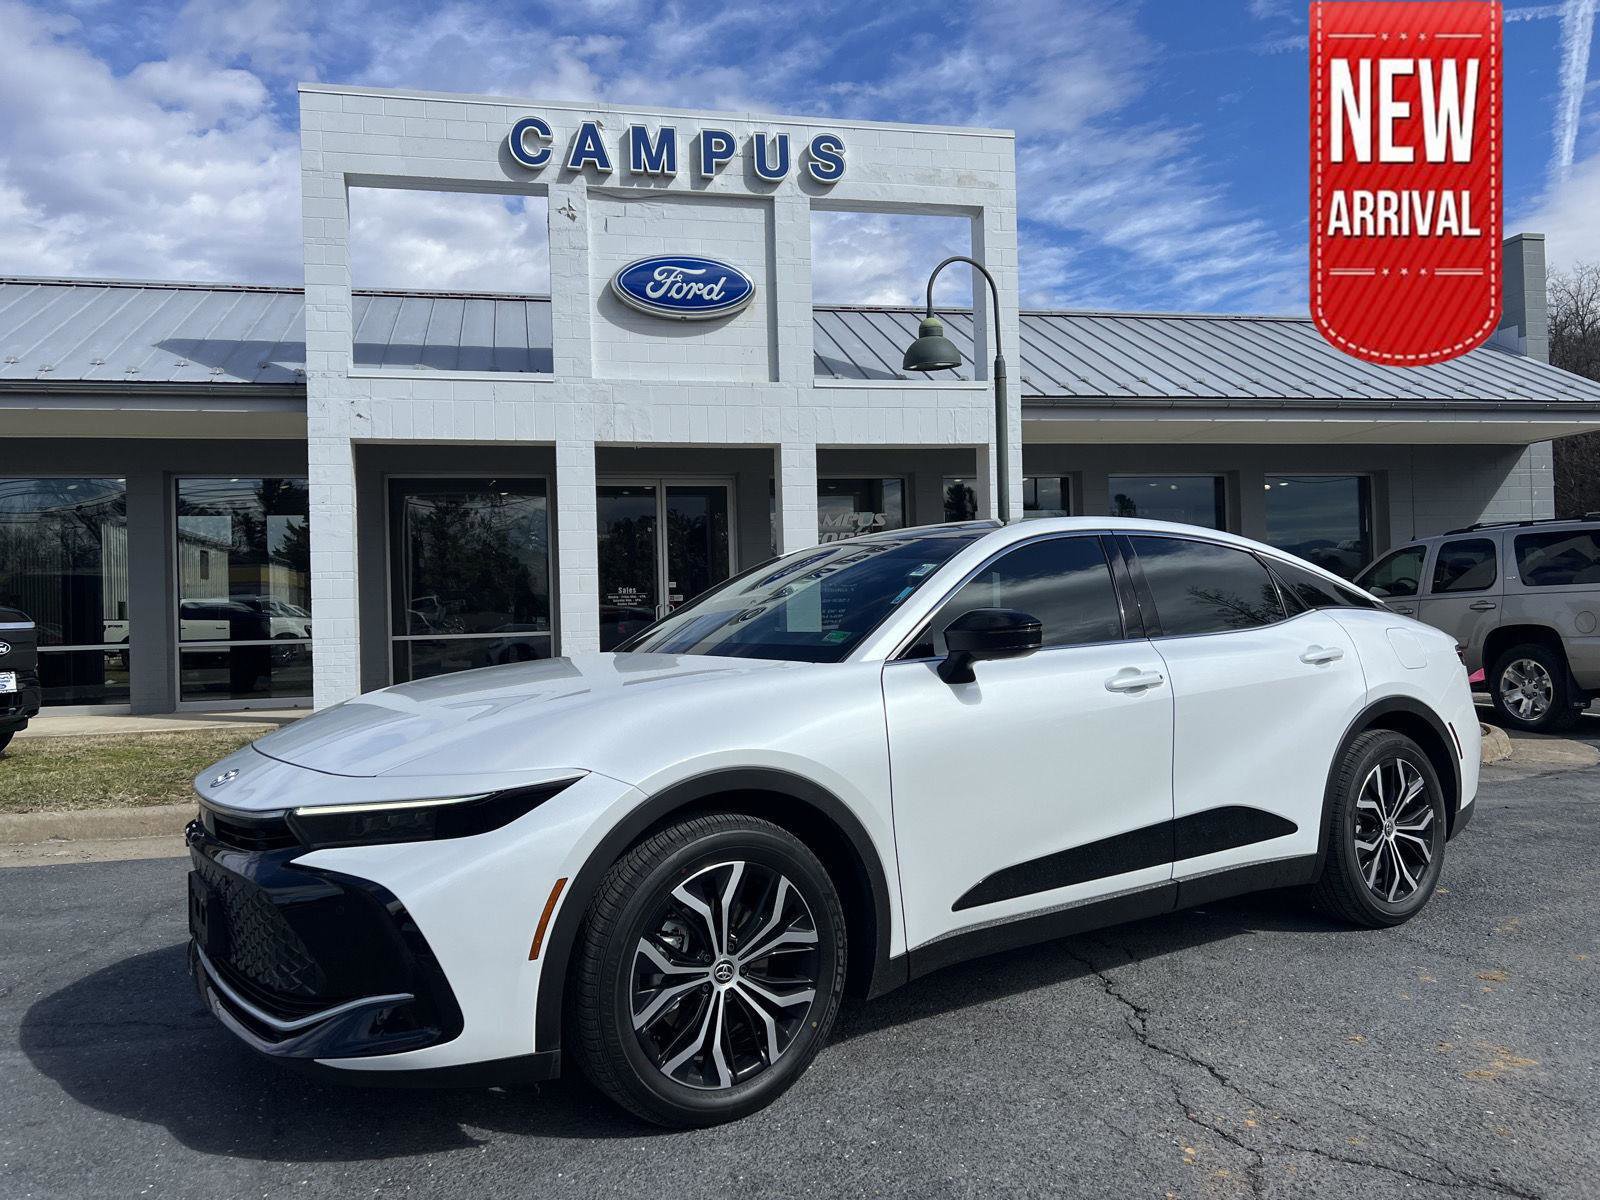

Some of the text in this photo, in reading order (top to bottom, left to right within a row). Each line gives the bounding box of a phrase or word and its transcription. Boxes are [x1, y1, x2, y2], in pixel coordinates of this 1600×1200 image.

[508, 116, 846, 185] CAMPUS
[645, 265, 727, 301] Ford
[818, 512, 887, 528] MPUS
